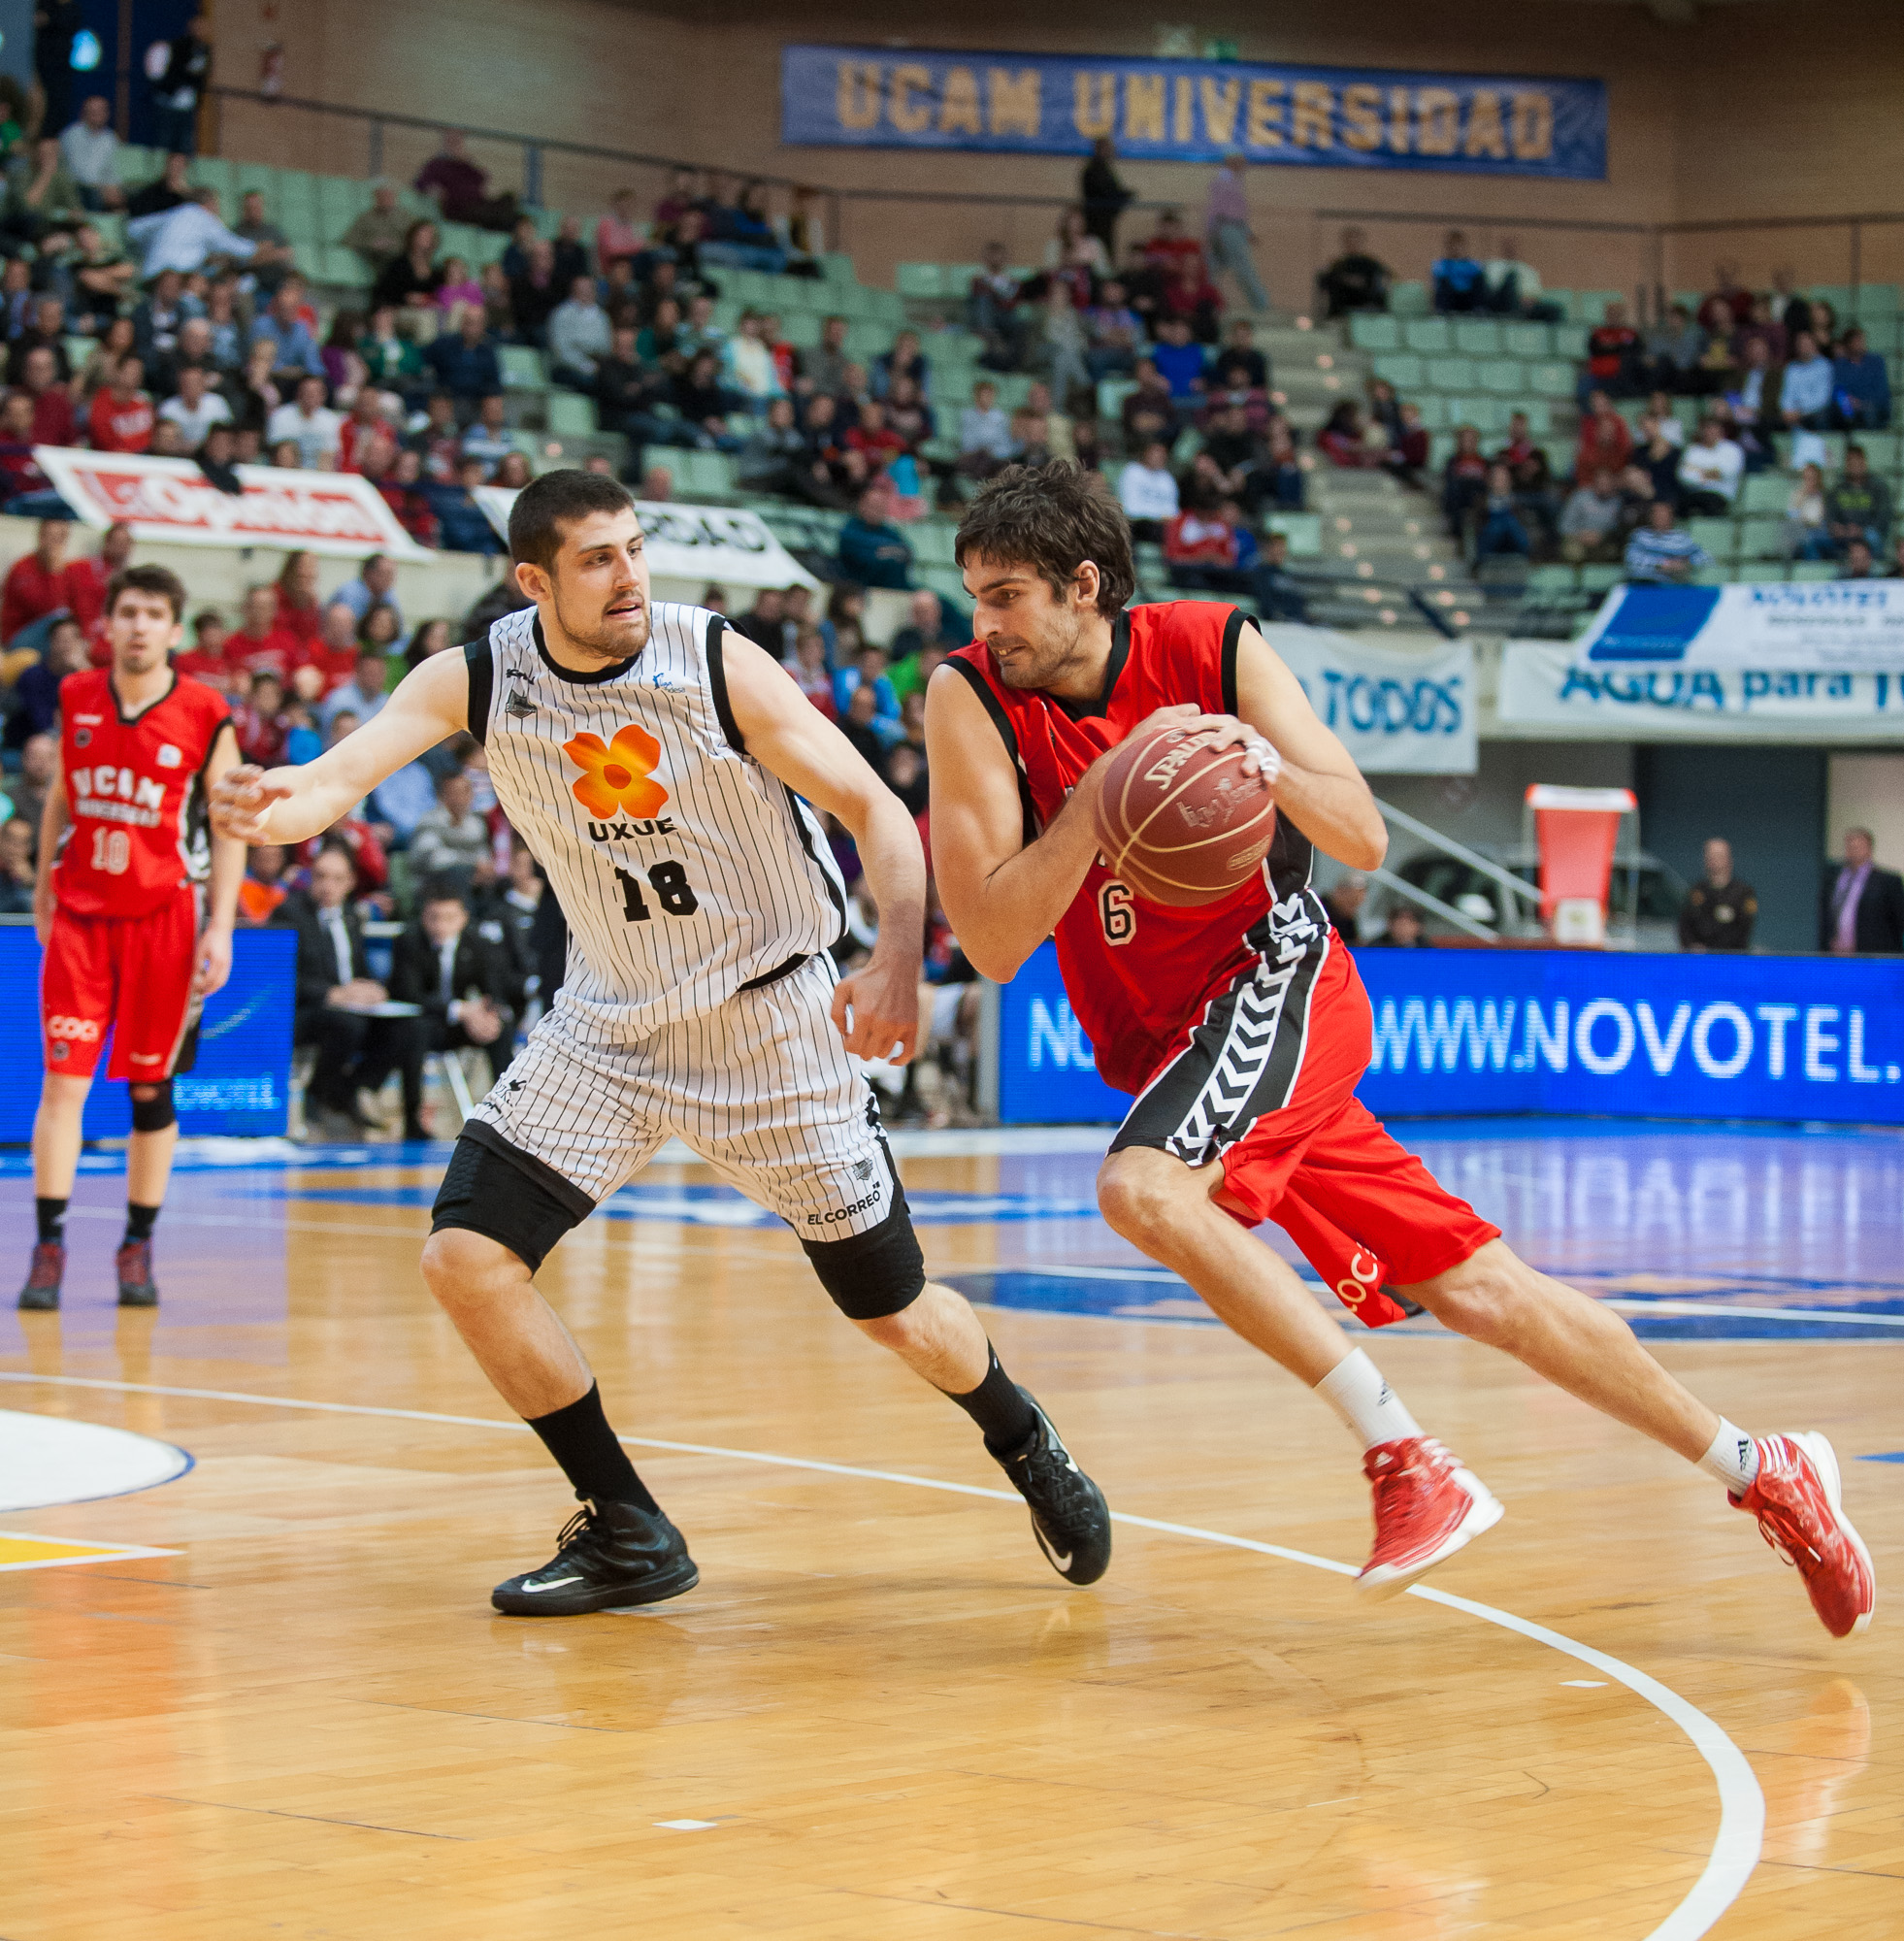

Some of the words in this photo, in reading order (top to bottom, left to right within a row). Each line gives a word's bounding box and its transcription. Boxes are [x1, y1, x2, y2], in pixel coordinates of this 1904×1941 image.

[835, 60, 1042, 138] UCAM
[1071, 70, 1555, 161] UNIVERSIDAD
[1324, 667, 1463, 734] TODOS
[1743, 670, 1852, 710] para
[71, 764, 168, 810] UCAM
[90, 825, 131, 875] 10
[588, 816, 677, 842] UXUE
[613, 859, 699, 923] 18
[1098, 877, 1137, 946] 6
[807, 1213, 824, 1226] EL
[824, 1190, 881, 1224] CORREO
